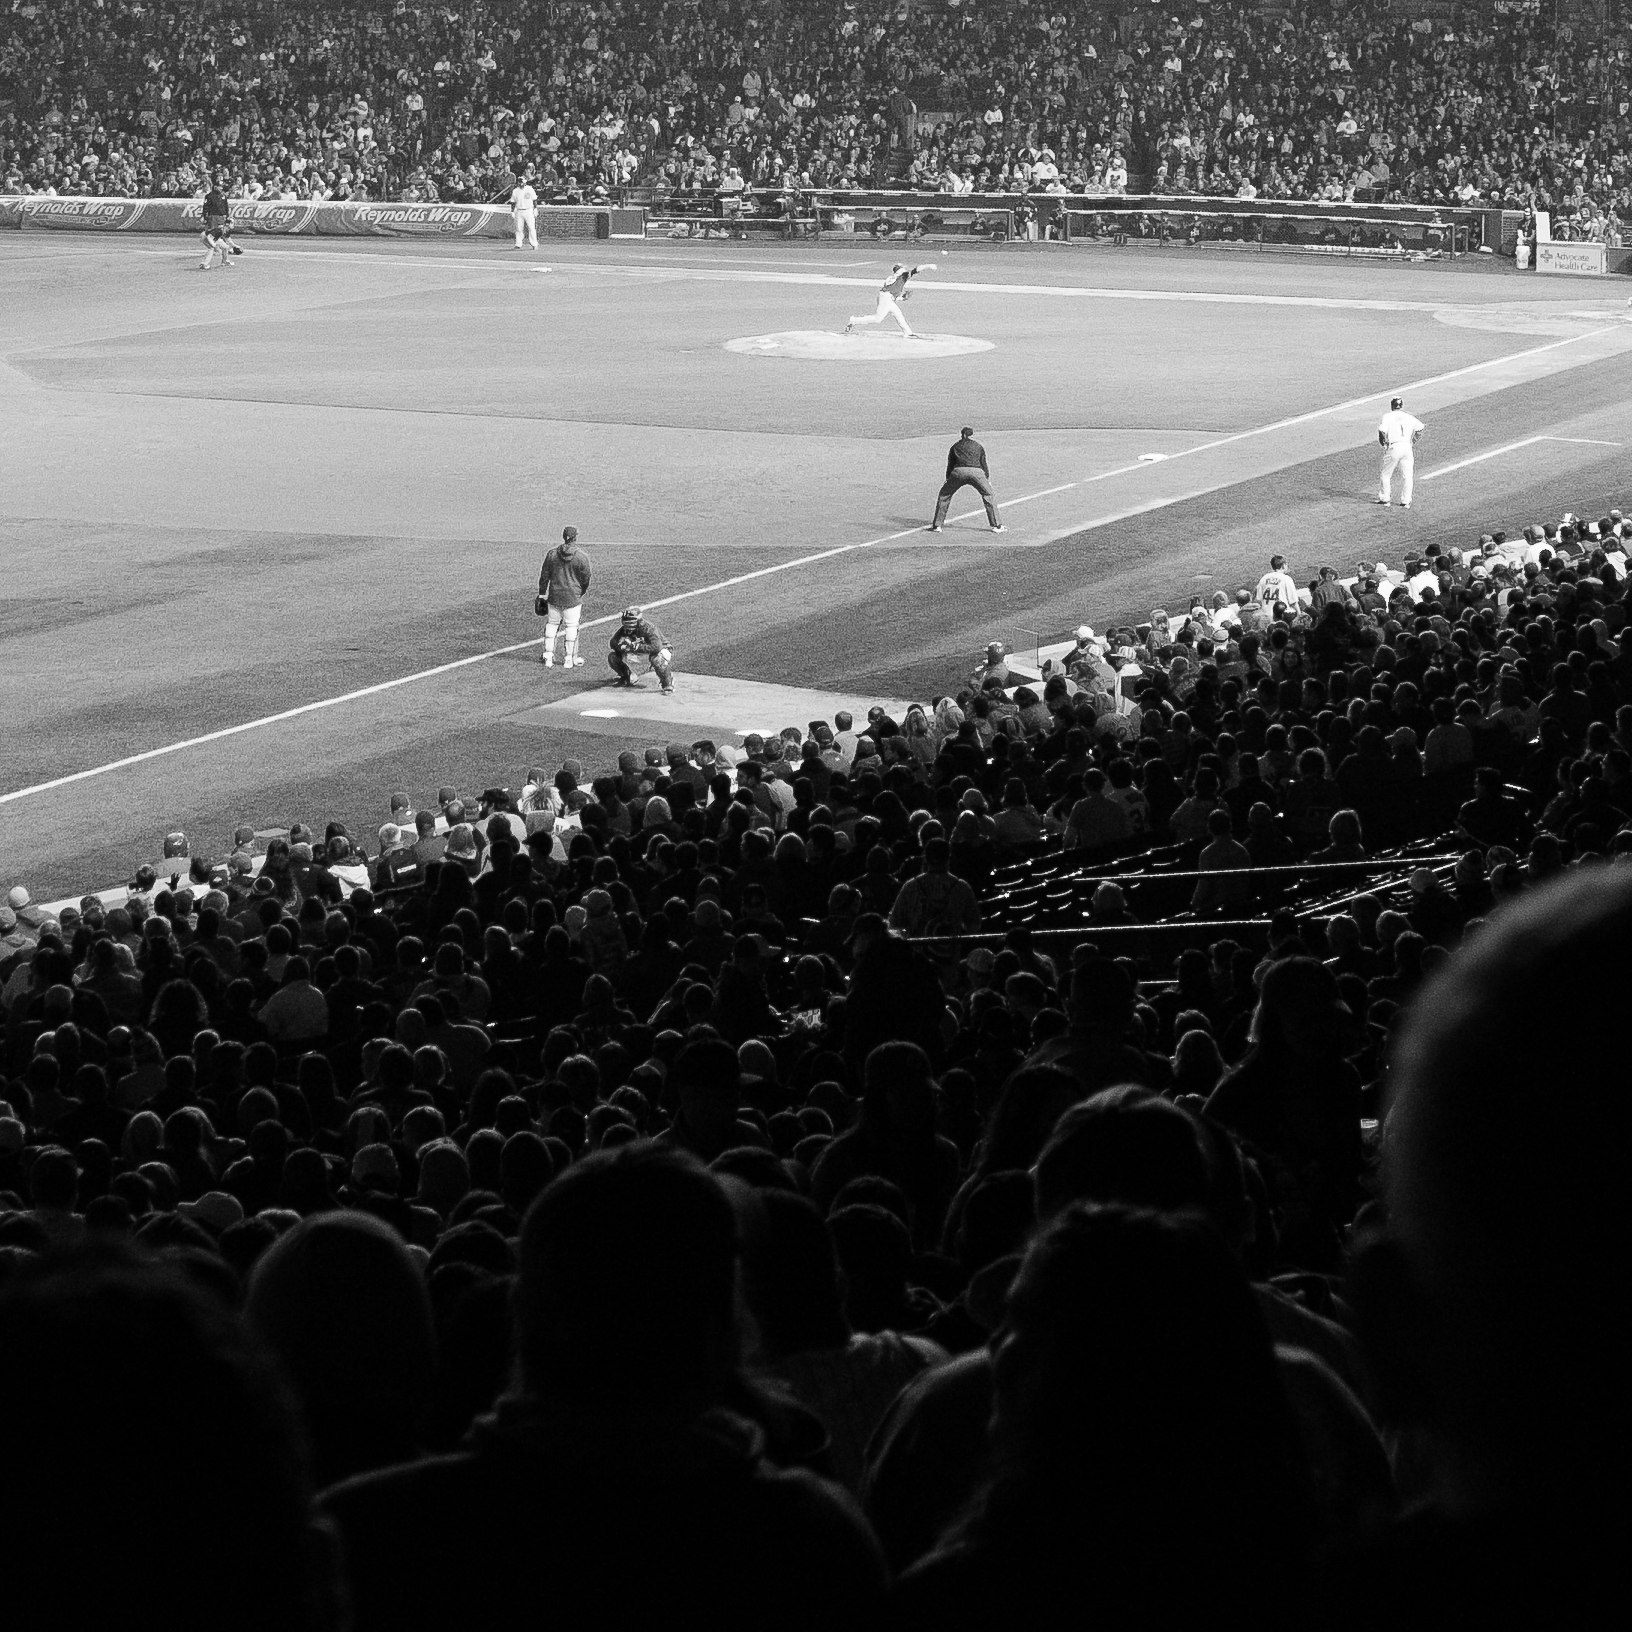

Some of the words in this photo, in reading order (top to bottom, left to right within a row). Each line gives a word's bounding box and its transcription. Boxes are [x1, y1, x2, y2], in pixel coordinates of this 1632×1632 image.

[14, 199, 85, 217] Reynolds
[84, 200, 125, 218] Wrap
[254, 204, 296, 220] Wrap
[353, 206, 427, 225] Reynolds
[427, 207, 472, 225] Wrap
[1555, 252, 1590, 262] Advocate
[1554, 261, 1578, 271] Health
[1580, 262, 1598, 272] Care
[1263, 587, 1280, 605] 44
